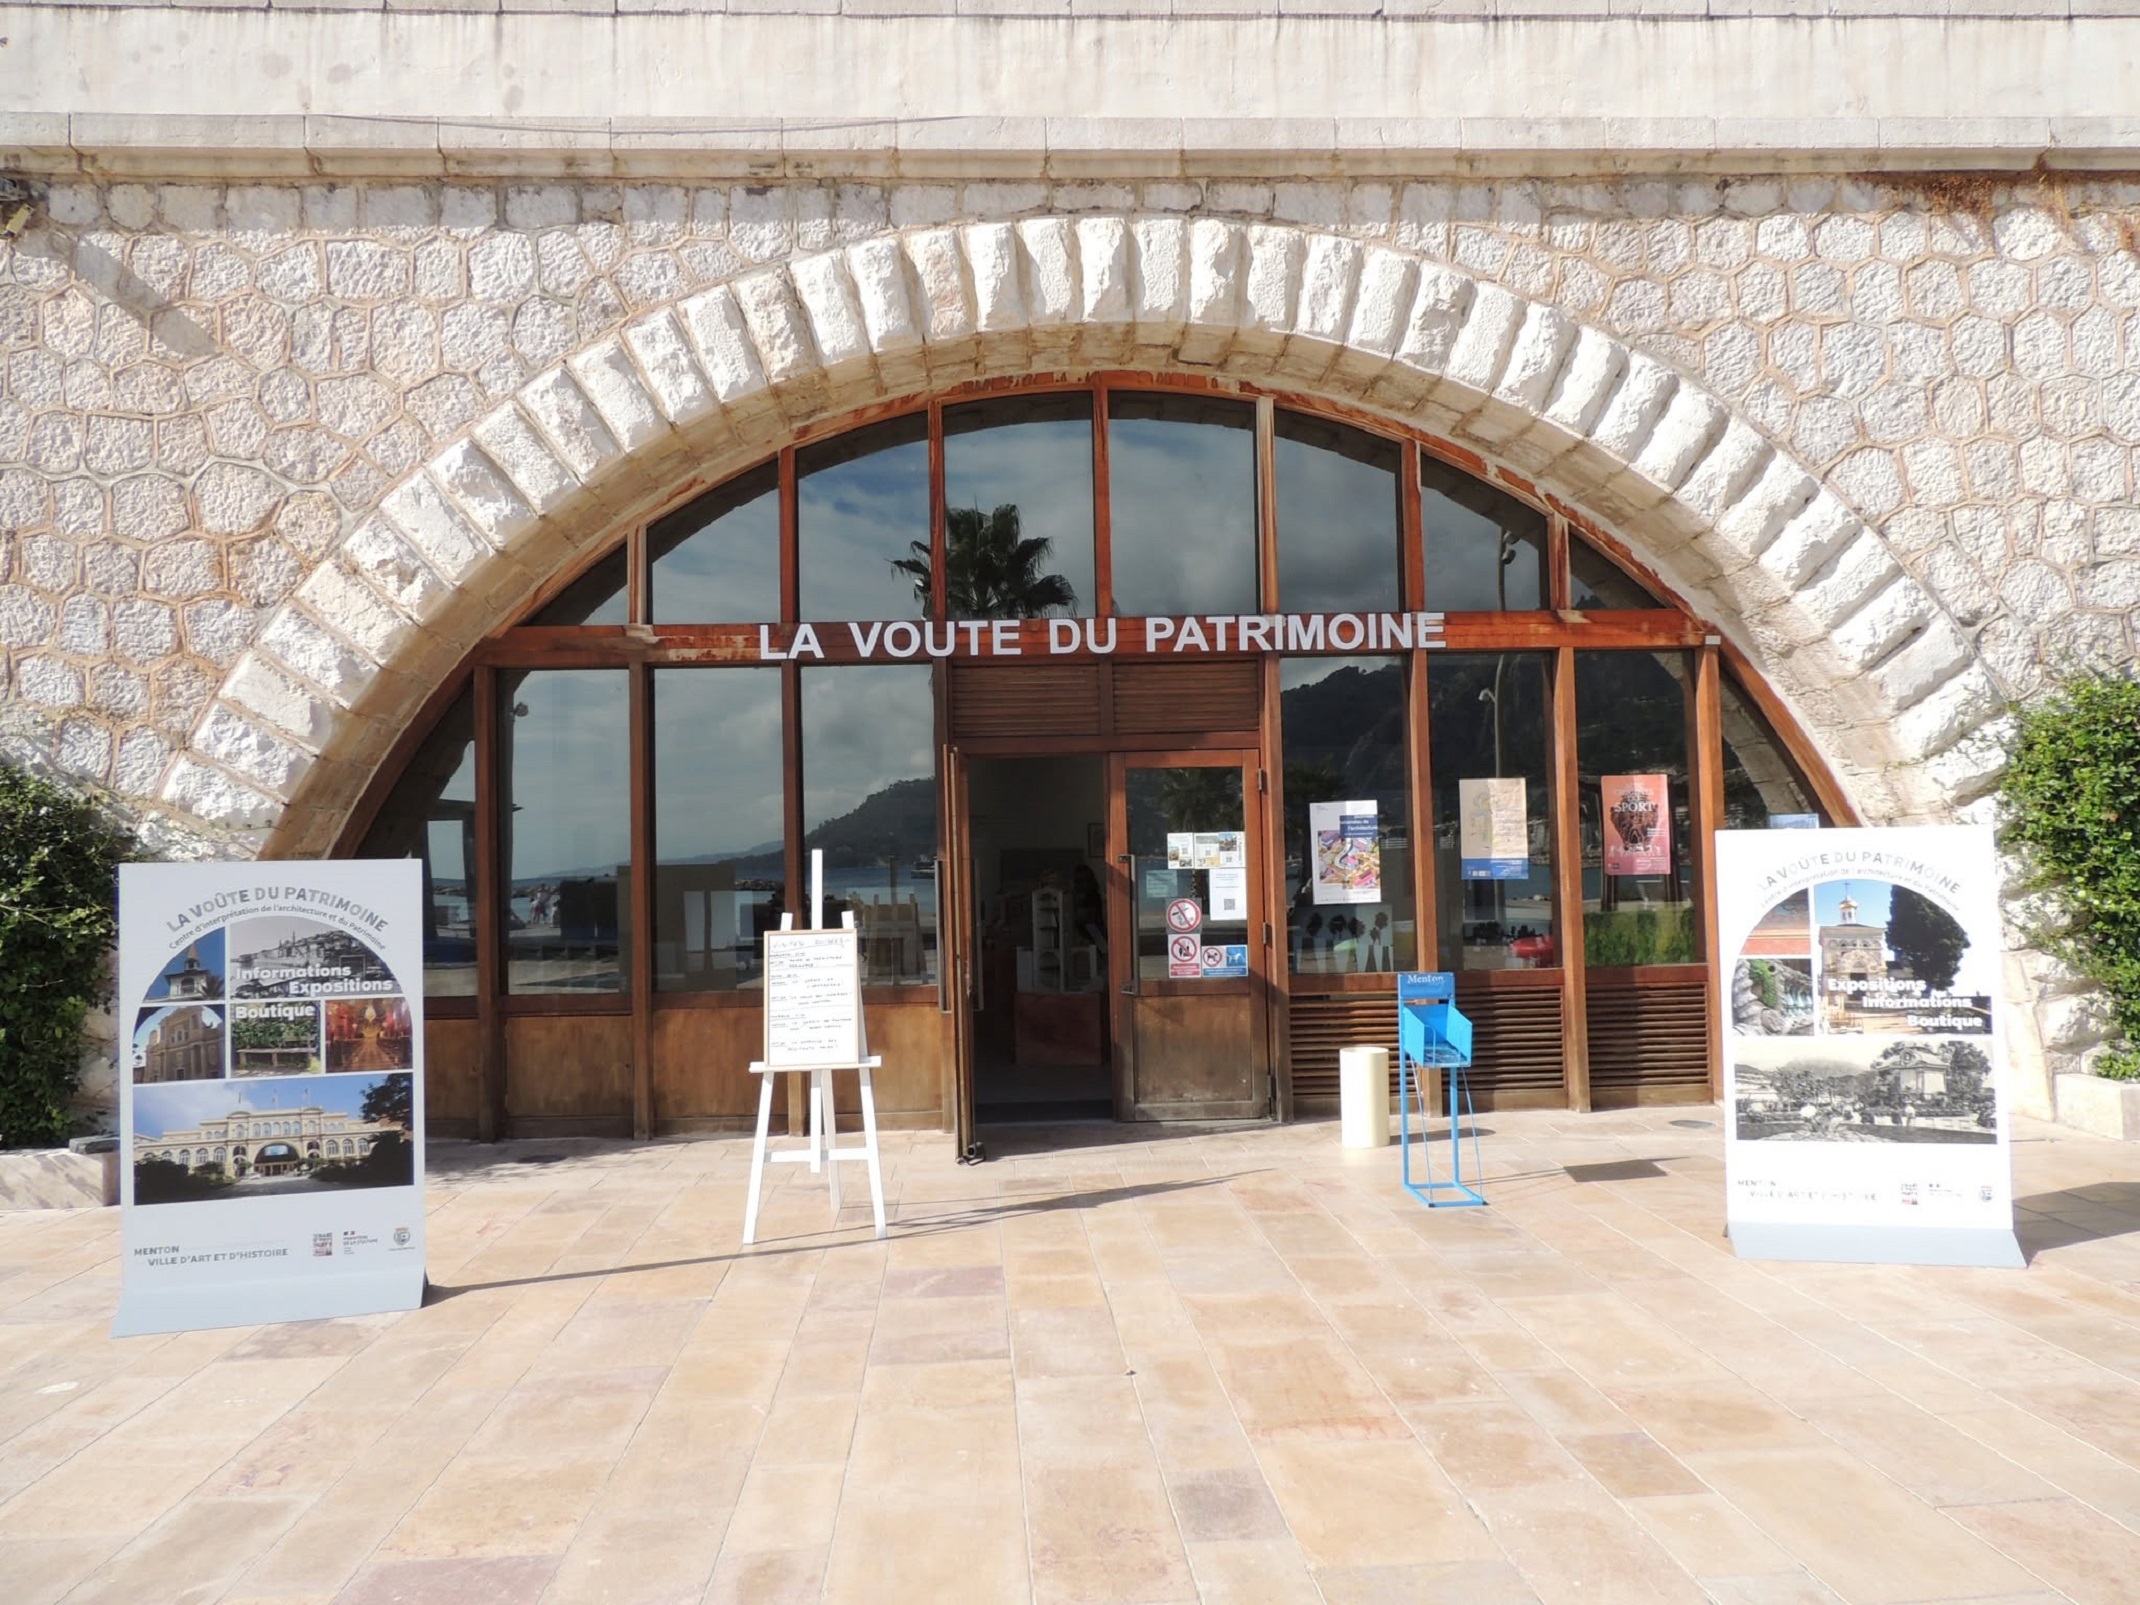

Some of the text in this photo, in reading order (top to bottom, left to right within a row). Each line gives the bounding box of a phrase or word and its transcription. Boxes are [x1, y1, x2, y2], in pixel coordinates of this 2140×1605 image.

[760, 612, 1446, 660] LA VOUTE DU PATRIMOINE
[1614, 802, 1654, 812] SPORT
[1834, 851, 1856, 864] DU
[1862, 851, 1962, 894] PATRIMOINE
[166, 886, 389, 933] LA VOÛTE DU PATRIMOINE
[168, 930, 195, 950] Centre
[261, 904, 272, 912] de
[273, 903, 328, 918] l'architecture
[328, 912, 338, 921] et
[338, 915, 349, 926] du
[349, 922, 387, 951] Patrimoine
[236, 965, 352, 981] Informations
[1407, 974, 1444, 984] Menton
[288, 978, 394, 997] Expositions
[1828, 978, 1927, 996] Expositions
[1862, 994, 1973, 1008] Informations
[235, 1004, 317, 1021] Boutique
[1906, 1014, 1984, 1030] Boutique
[134, 1245, 180, 1256] MENTON
[147, 1248, 289, 1267] VILLE D'ART ET D'HISTOIRE
